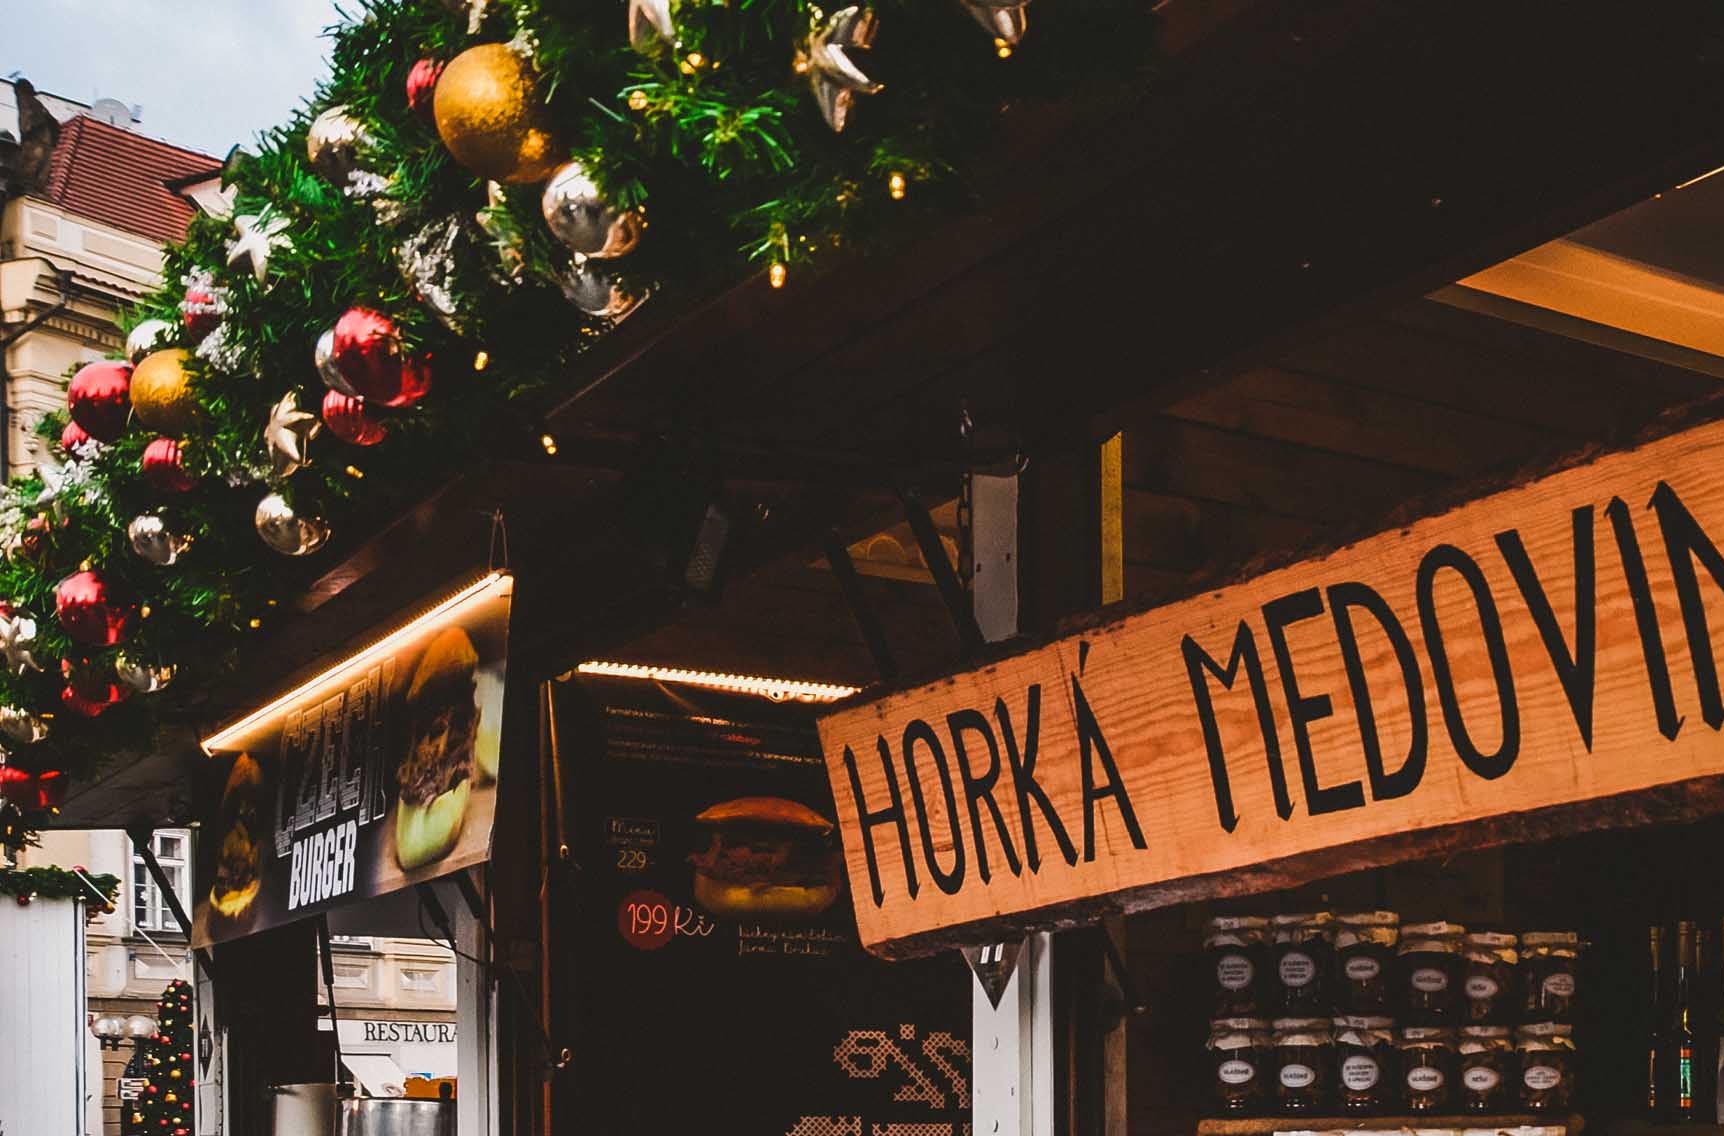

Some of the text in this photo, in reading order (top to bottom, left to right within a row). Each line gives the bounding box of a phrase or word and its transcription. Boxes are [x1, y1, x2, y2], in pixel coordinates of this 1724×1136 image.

[843, 640, 1149, 908] HORKÁ
[288, 820, 358, 910] BURGER
[627, 903, 669, 935] 199
